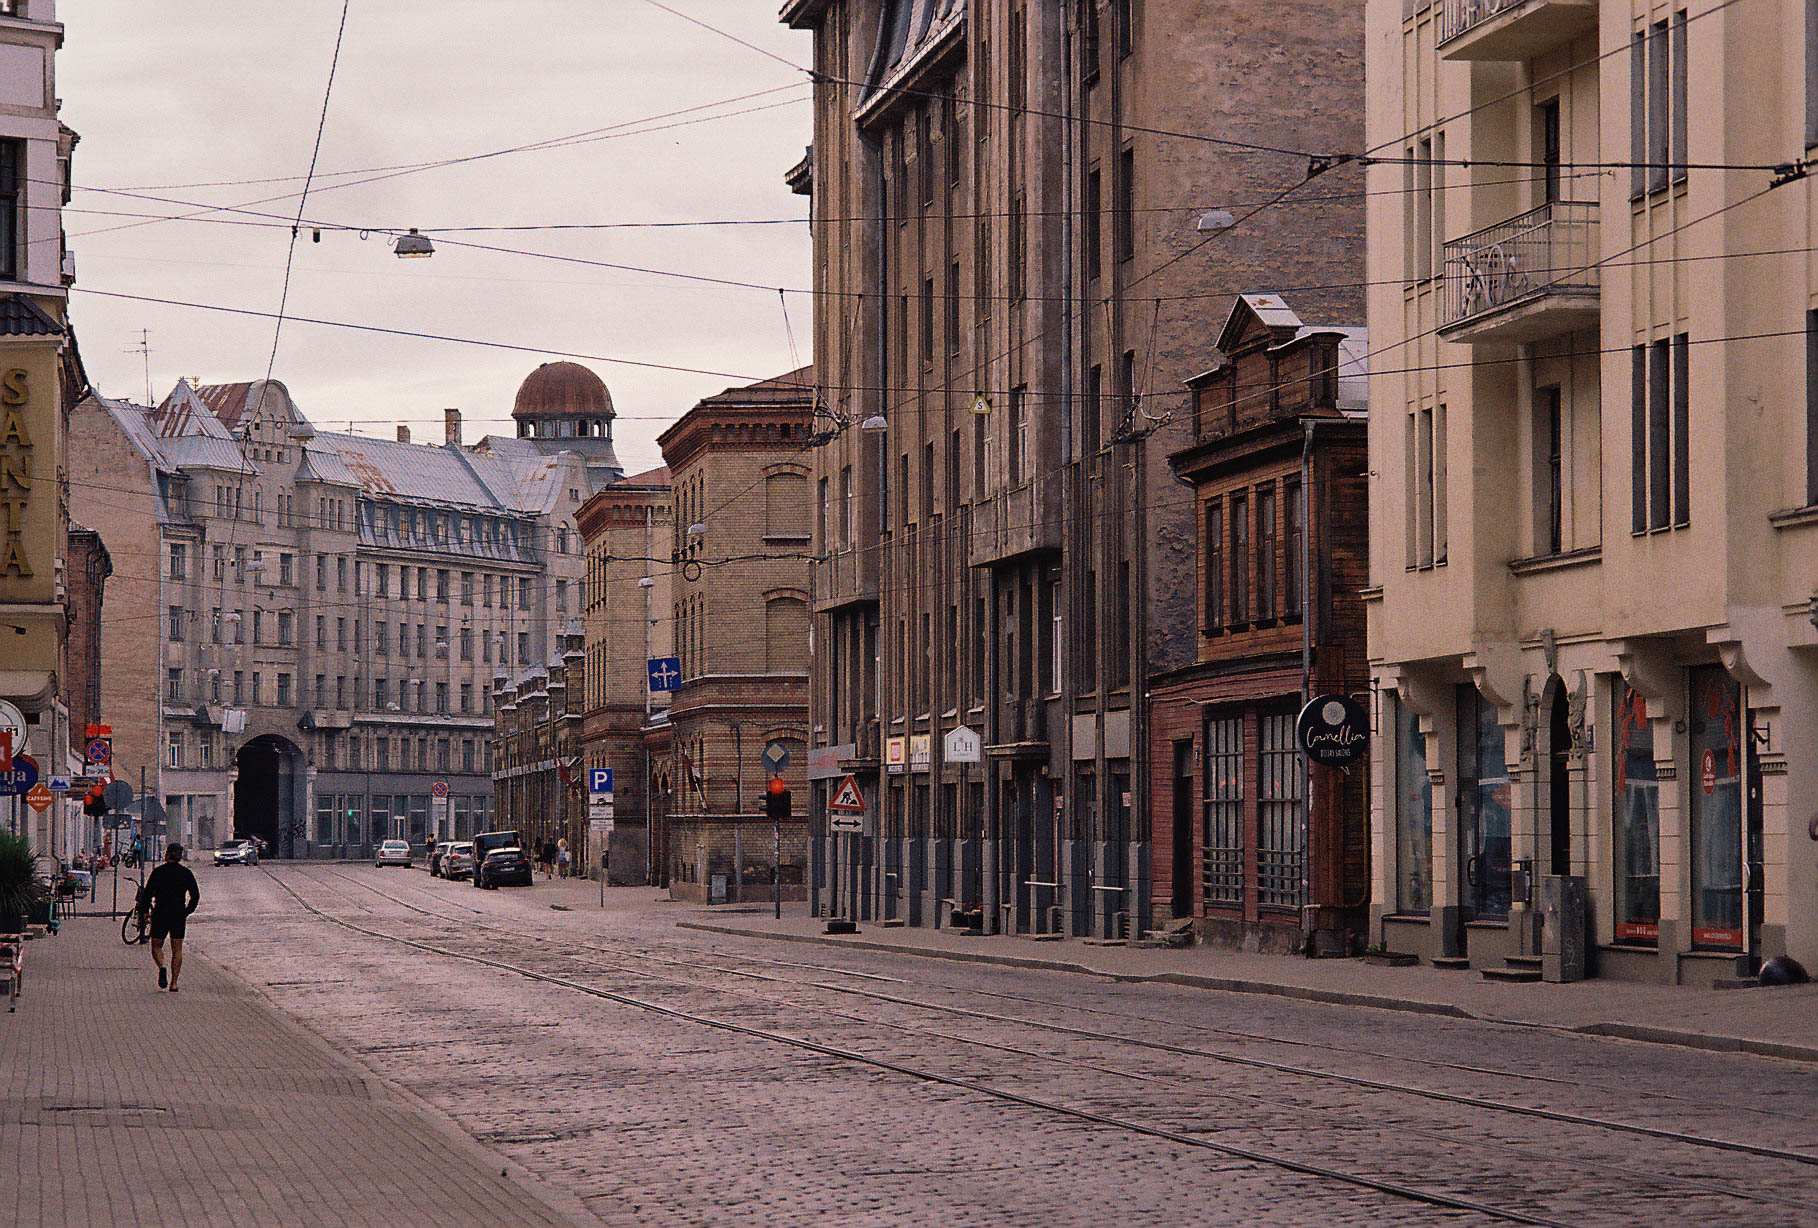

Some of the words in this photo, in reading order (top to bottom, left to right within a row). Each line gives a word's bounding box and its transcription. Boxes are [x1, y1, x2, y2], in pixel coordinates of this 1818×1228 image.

[978, 401, 983, 410] S
[0, 368, 34, 578] SANTA
[1306, 724, 1366, 748] Camellia
[0, 766, 26, 785] ija
[594, 771, 608, 790] P
